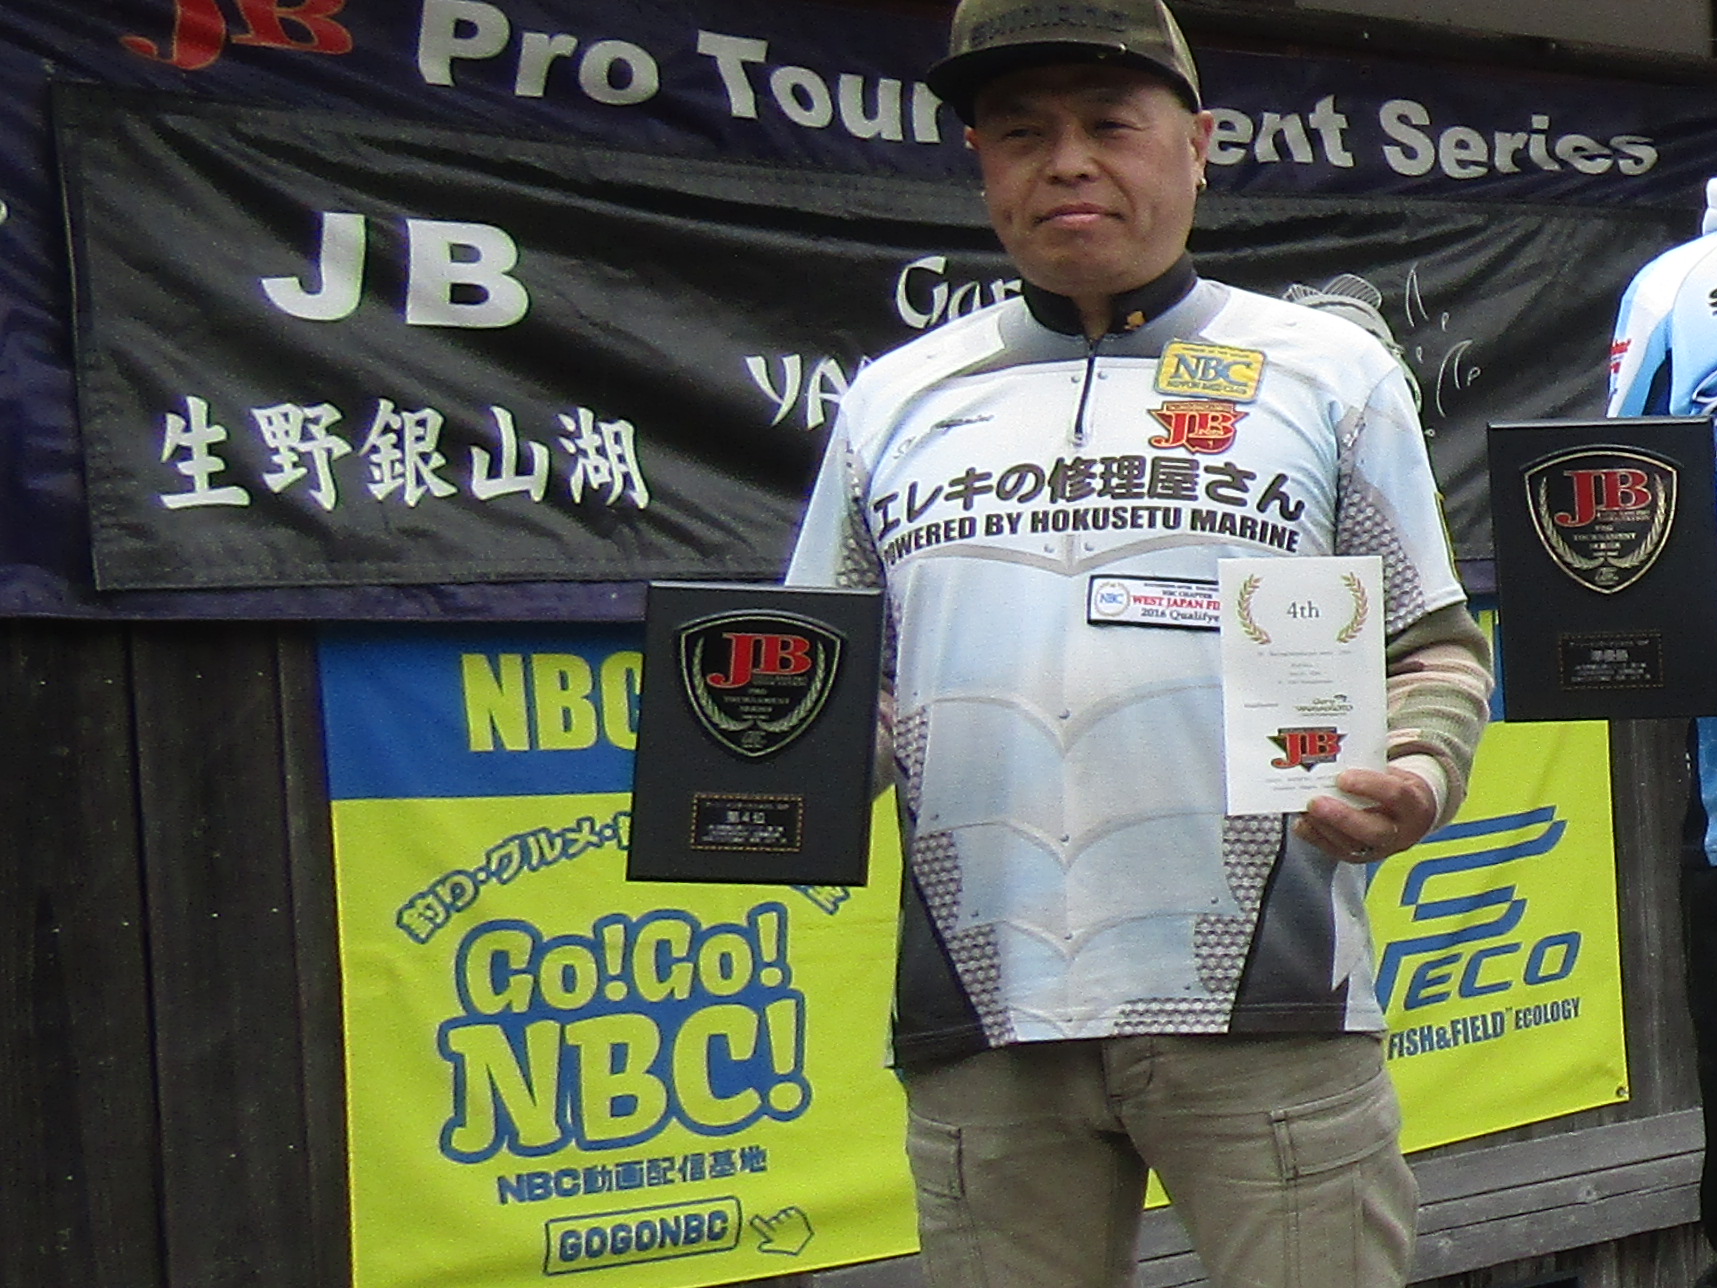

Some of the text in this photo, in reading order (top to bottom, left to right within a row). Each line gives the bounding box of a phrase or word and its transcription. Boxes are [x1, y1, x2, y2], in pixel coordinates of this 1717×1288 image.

[1379, 98, 1661, 180] Series
[260, 211, 530, 328] JB
[1170, 353, 1253, 387] NBC
[160, 396, 651, 512] 生野銀山湖
[873, 454, 1305, 541] エレキの修理屋さん
[1554, 468, 1651, 527] JB
[985, 510, 1022, 536] BY
[1031, 506, 1183, 533] HOKUSETU
[1190, 509, 1301, 554] MARINE
[1132, 594, 1164, 607] WEST
[1166, 596, 1205, 610] JAPAN
[1287, 600, 1321, 620] 4th
[706, 631, 813, 689] JB
[1270, 733, 1343, 771] JB
[456, 902, 795, 1016] Go!Go!
[1514, 997, 1581, 1032] ECOLOGY
[440, 992, 812, 1163] NBC!
[559, 1209, 731, 1263] GOGONBC
